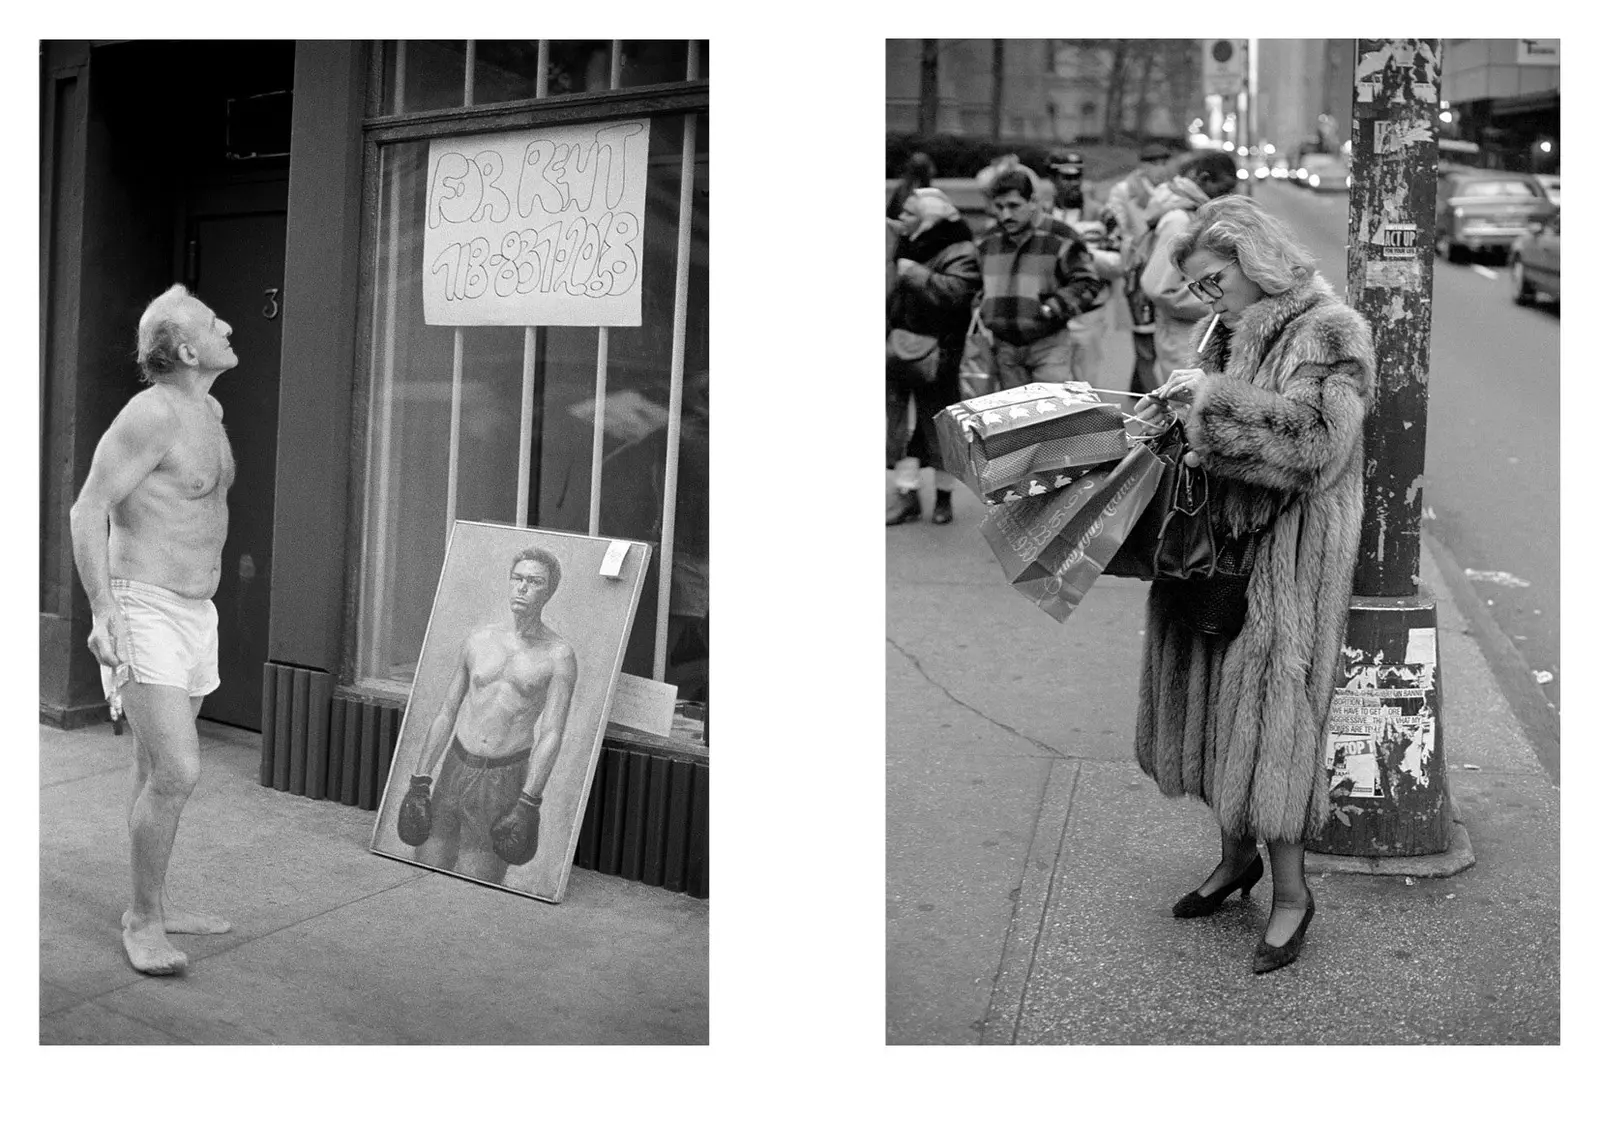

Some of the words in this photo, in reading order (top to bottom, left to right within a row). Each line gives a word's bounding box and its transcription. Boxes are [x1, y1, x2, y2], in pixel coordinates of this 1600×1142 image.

[428, 149, 511, 230] FOR
[516, 122, 644, 219] RENT
[1385, 231, 1402, 246] ACT
[1403, 231, 1416, 246] UP
[262, 288, 279, 320] 3
[1344, 707, 1359, 715] HAVE
[1360, 707, 1369, 715] TO
[1369, 707, 1381, 715] GET
